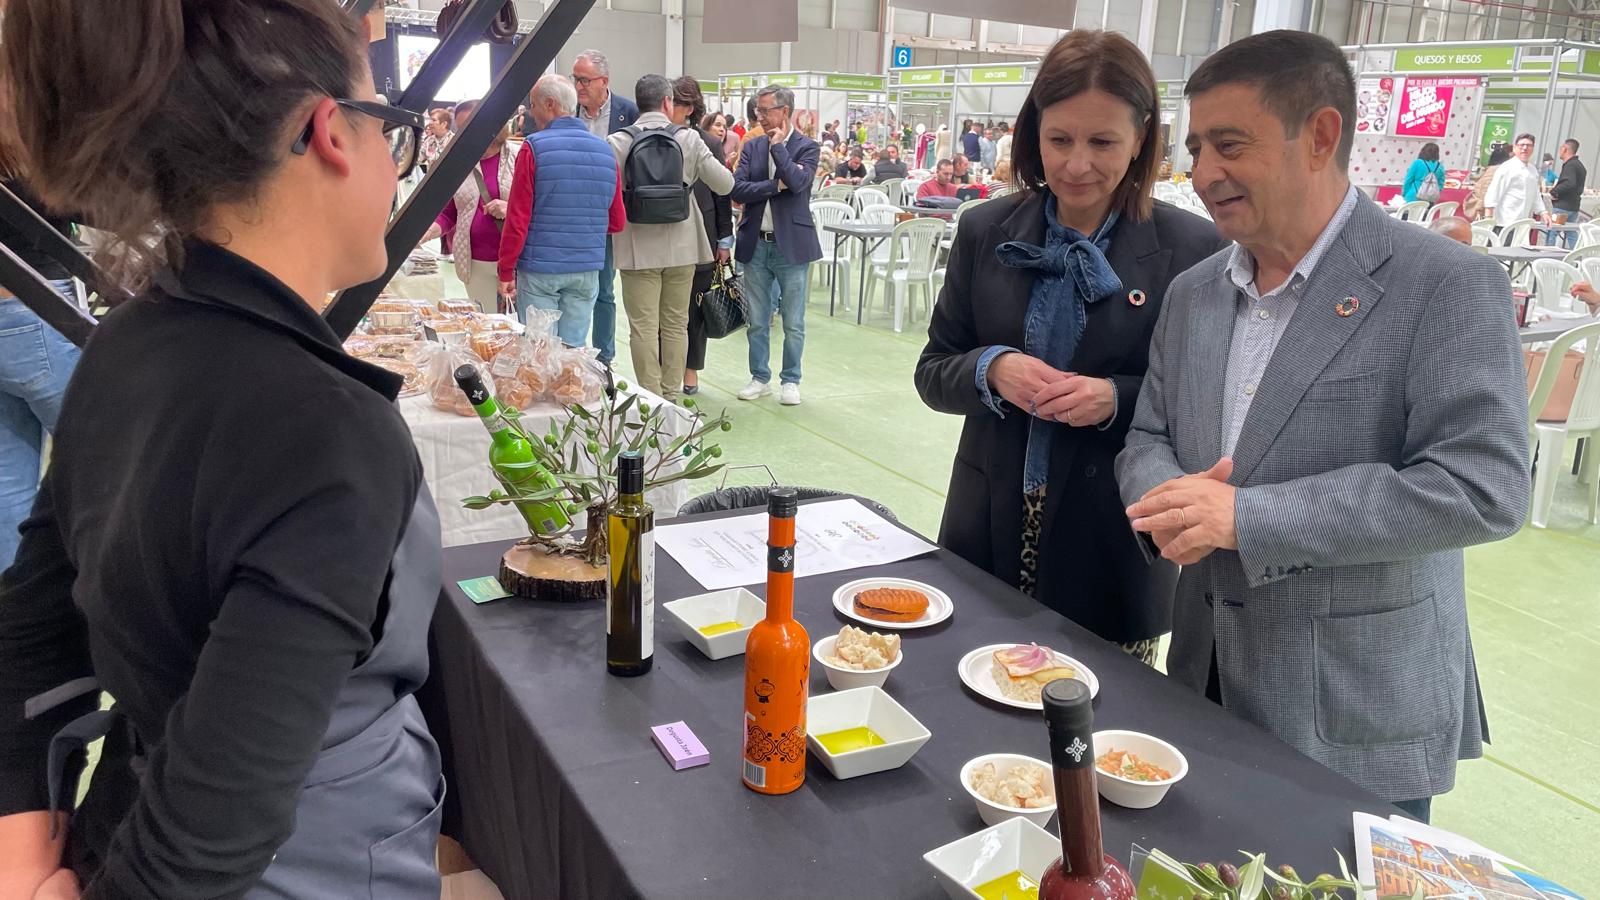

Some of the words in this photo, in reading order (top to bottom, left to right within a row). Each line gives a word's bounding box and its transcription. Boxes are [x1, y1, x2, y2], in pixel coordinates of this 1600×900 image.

[898, 50, 908, 65] 6
[1414, 55, 1446, 65] QUESOS
[1448, 55, 1455, 64] Y
[1455, 54, 1482, 64] BESOS
